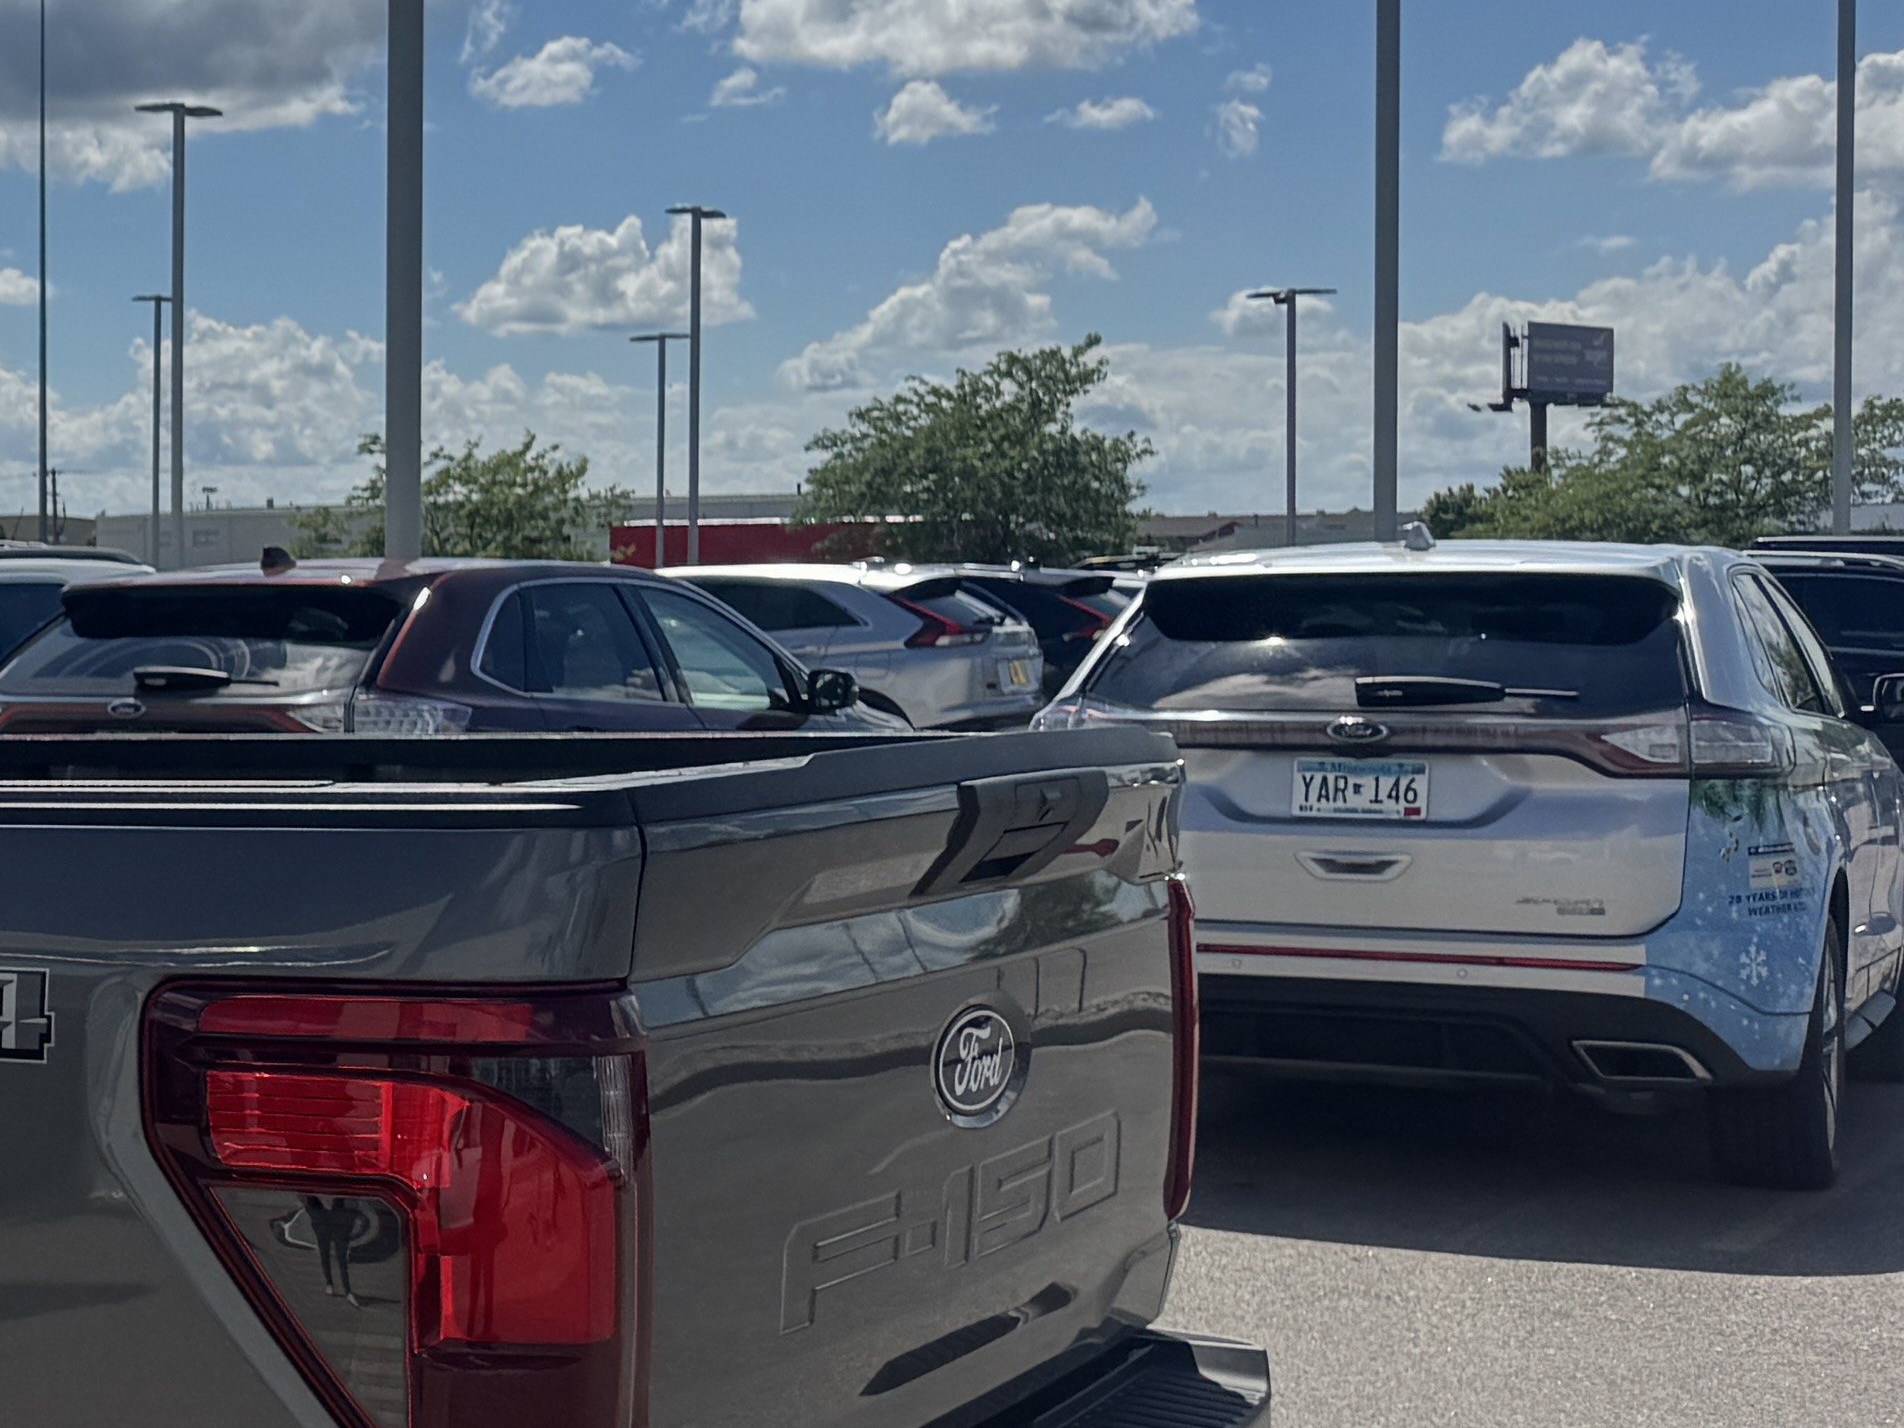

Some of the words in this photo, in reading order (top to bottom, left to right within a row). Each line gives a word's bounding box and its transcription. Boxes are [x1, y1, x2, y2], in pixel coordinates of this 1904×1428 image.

[1302, 774, 1349, 804] YAR
[1369, 775, 1418, 805] 146
[780, 1108, 1122, 1335] F-150
